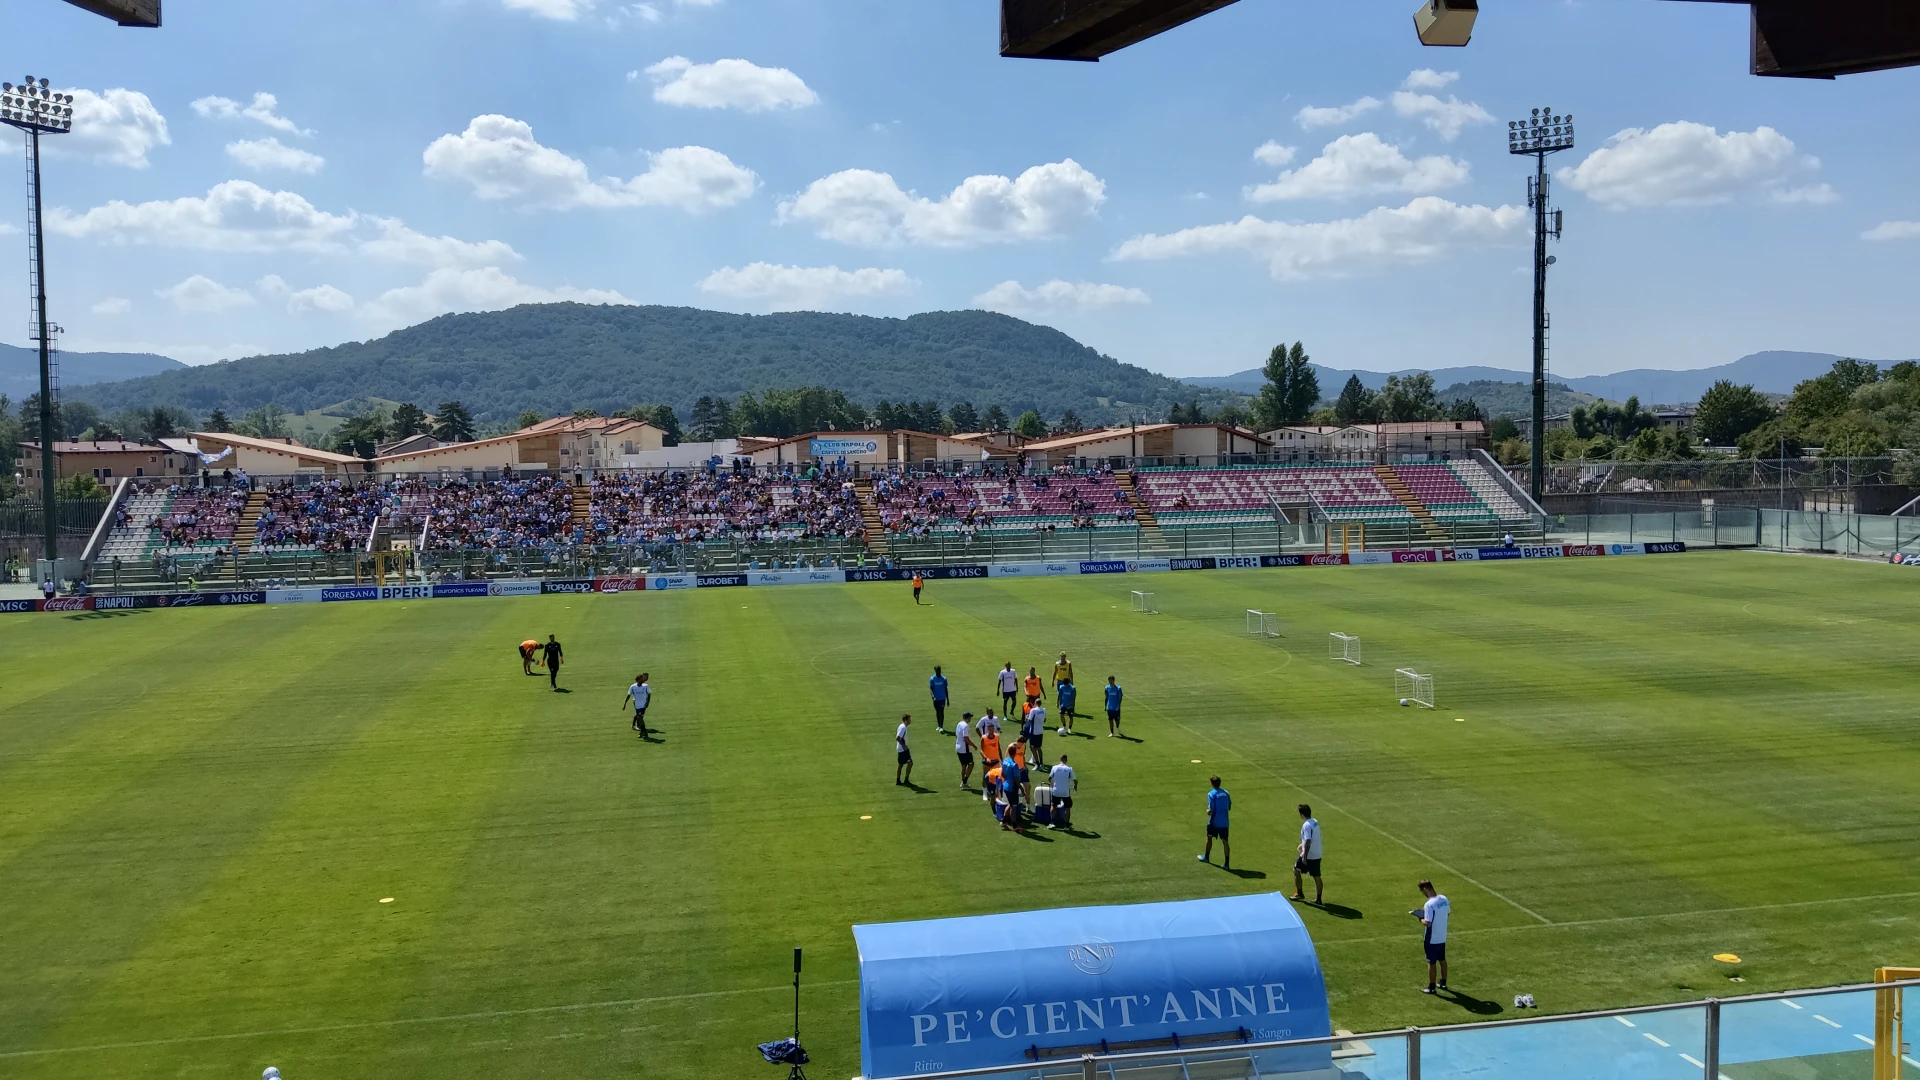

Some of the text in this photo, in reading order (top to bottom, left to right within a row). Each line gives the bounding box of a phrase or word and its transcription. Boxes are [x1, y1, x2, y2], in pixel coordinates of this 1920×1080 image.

[1568, 545, 1598, 556] Coca-Cola
[1660, 543, 1680, 552] MSC
[1278, 556, 1299, 565] MSC
[1310, 554, 1342, 565] Coca-Cola
[1400, 551, 1429, 562] enel
[1457, 551, 1473, 560] xtb
[1178, 559, 1202, 569] NAPOLI
[863, 571, 887, 580] MSC
[958, 568, 982, 577] MSC
[545, 582, 590, 591] TORALDO
[600, 579, 638, 591] Coca-Cola
[697, 577, 739, 586] EUROBET
[437, 587, 465, 595] euronics
[104, 597, 134, 608] NAPOLI
[231, 593, 259, 603] MSC
[0, 601, 28, 611] MSC
[43, 596, 86, 611] Coca-Cola
[911, 982, 1291, 1048] PE'CIENT'ANNE
[1259, 1027, 1292, 1041] Sangro
[914, 1059, 943, 1073] Ritiro
